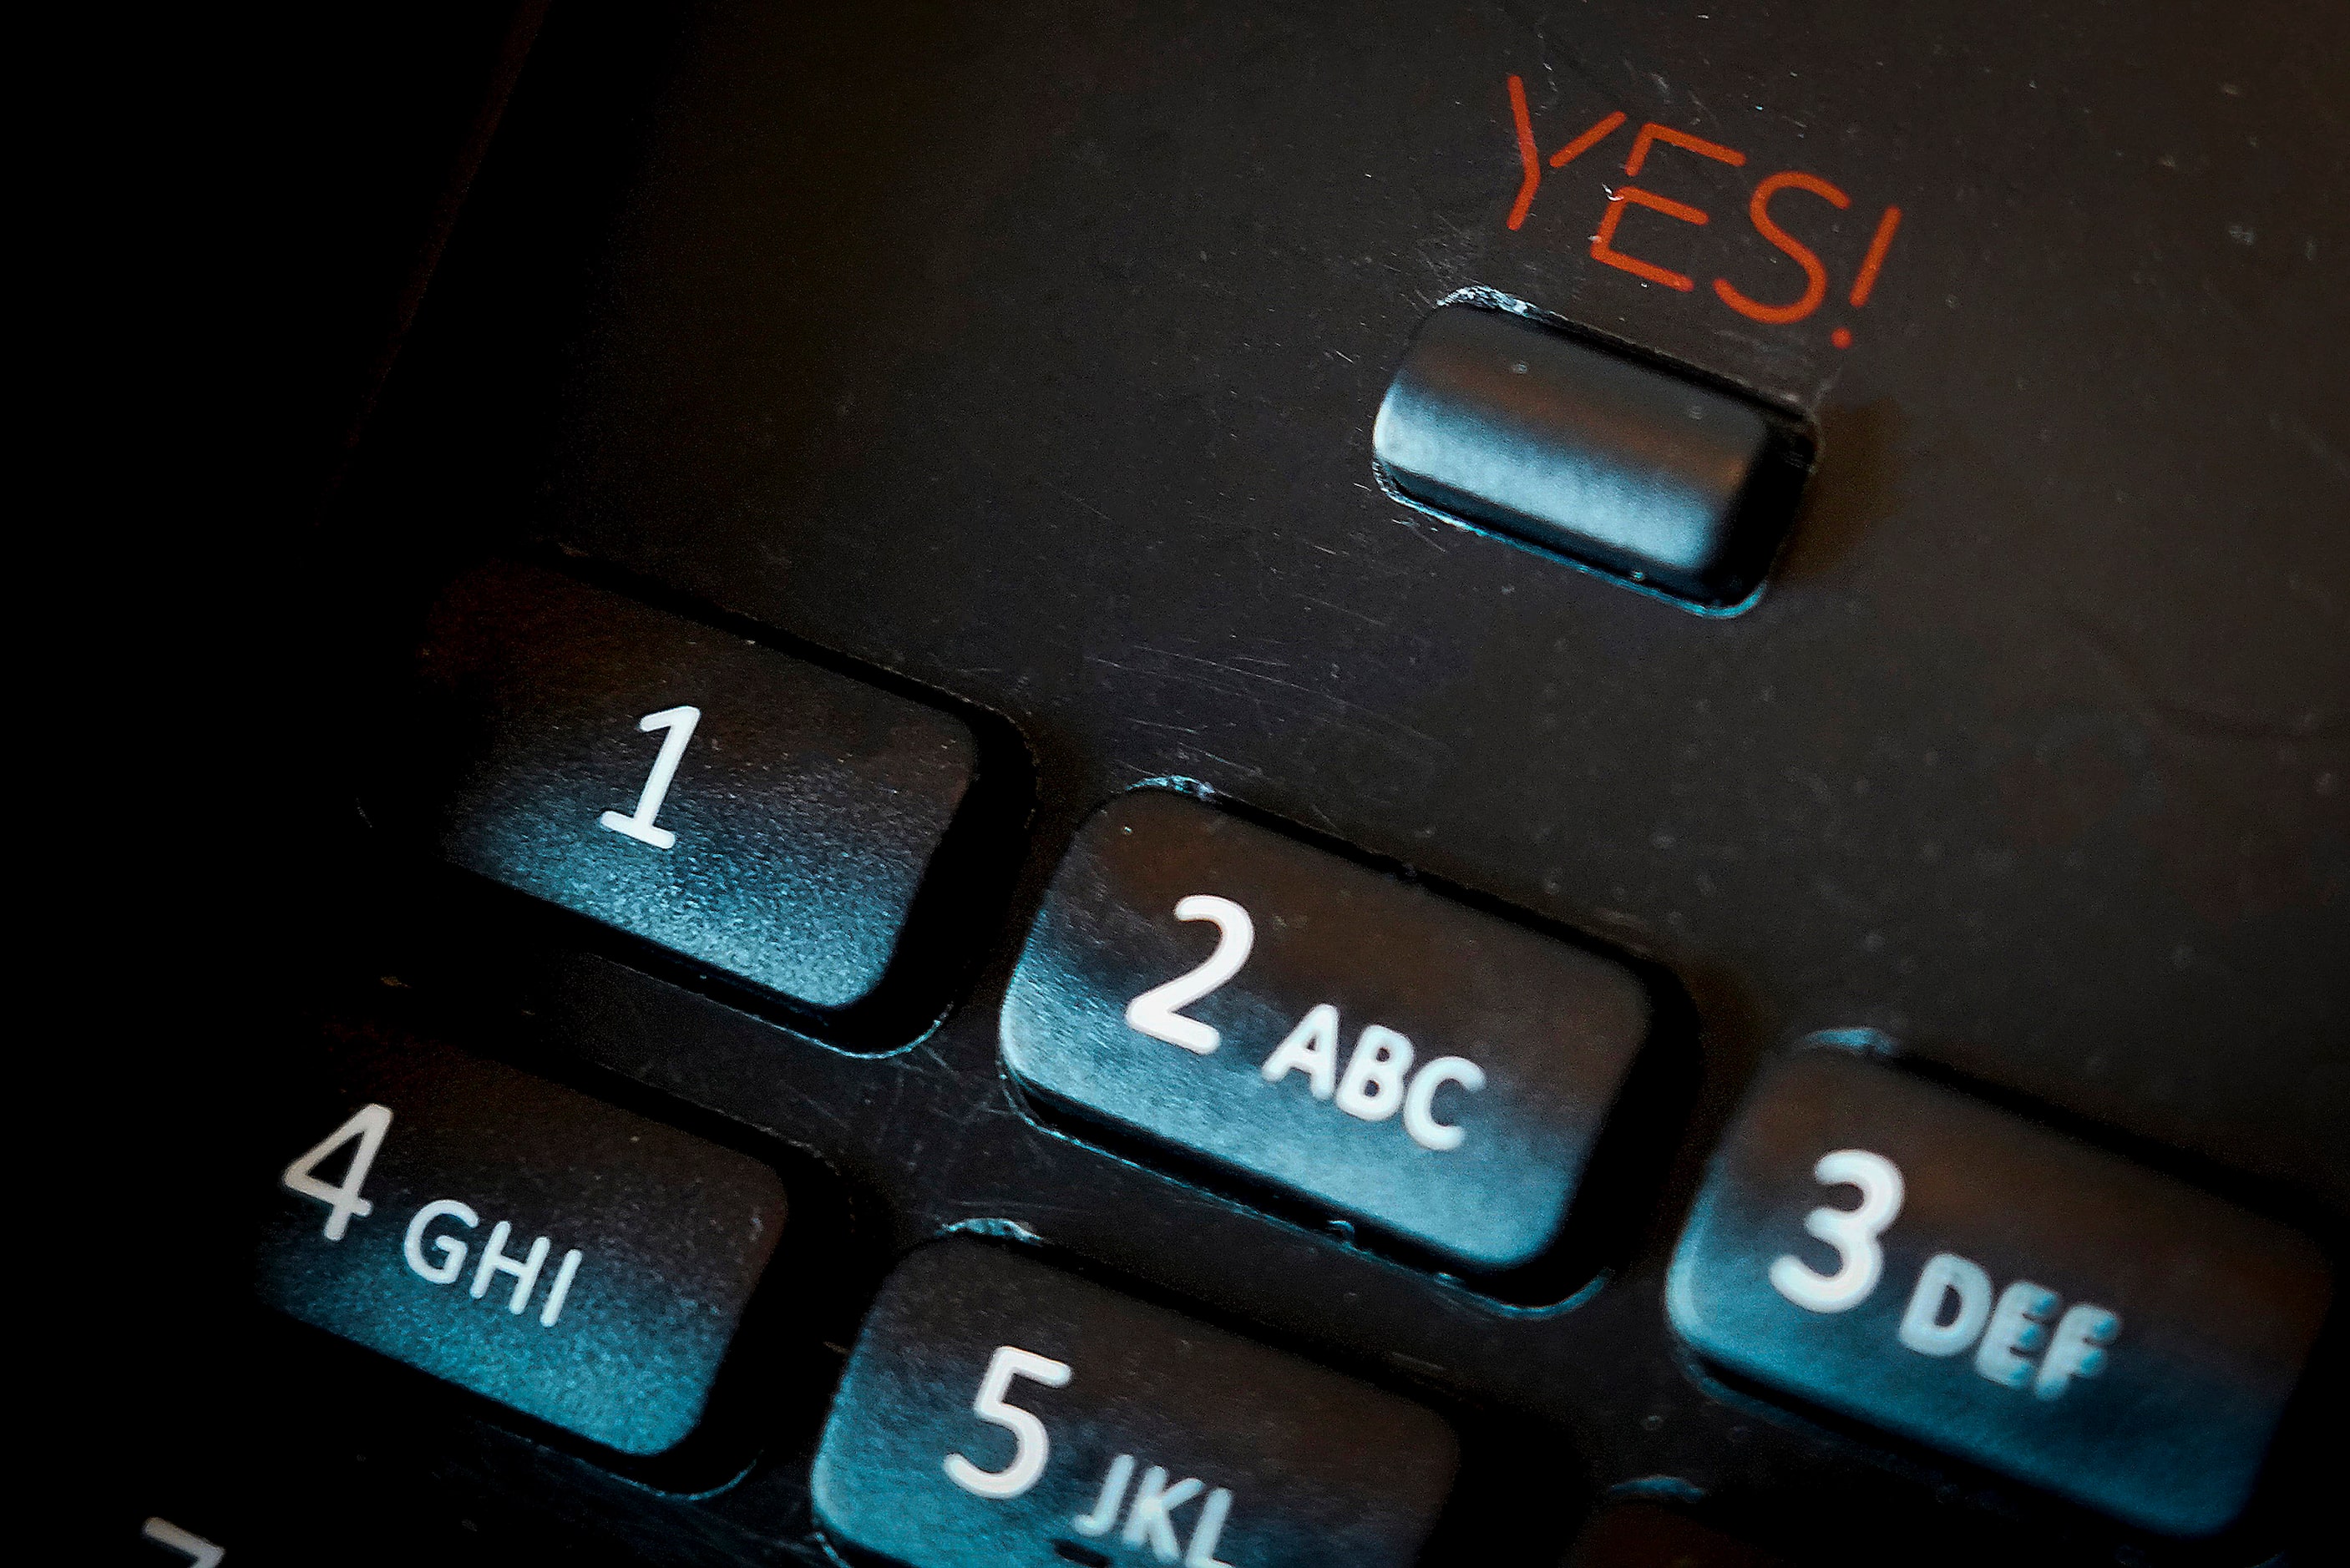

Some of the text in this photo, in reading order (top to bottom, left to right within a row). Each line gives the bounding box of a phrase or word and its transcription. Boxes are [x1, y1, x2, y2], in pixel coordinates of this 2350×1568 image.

[1507, 74, 1903, 350] YES!
[597, 704, 701, 851] 1
[1123, 894, 1488, 1154] 2 ABC
[282, 1102, 584, 1328] 4 GHI
[1768, 1148, 2123, 1401] 3 DEF
[942, 1344, 1235, 1568] 5 JKL
